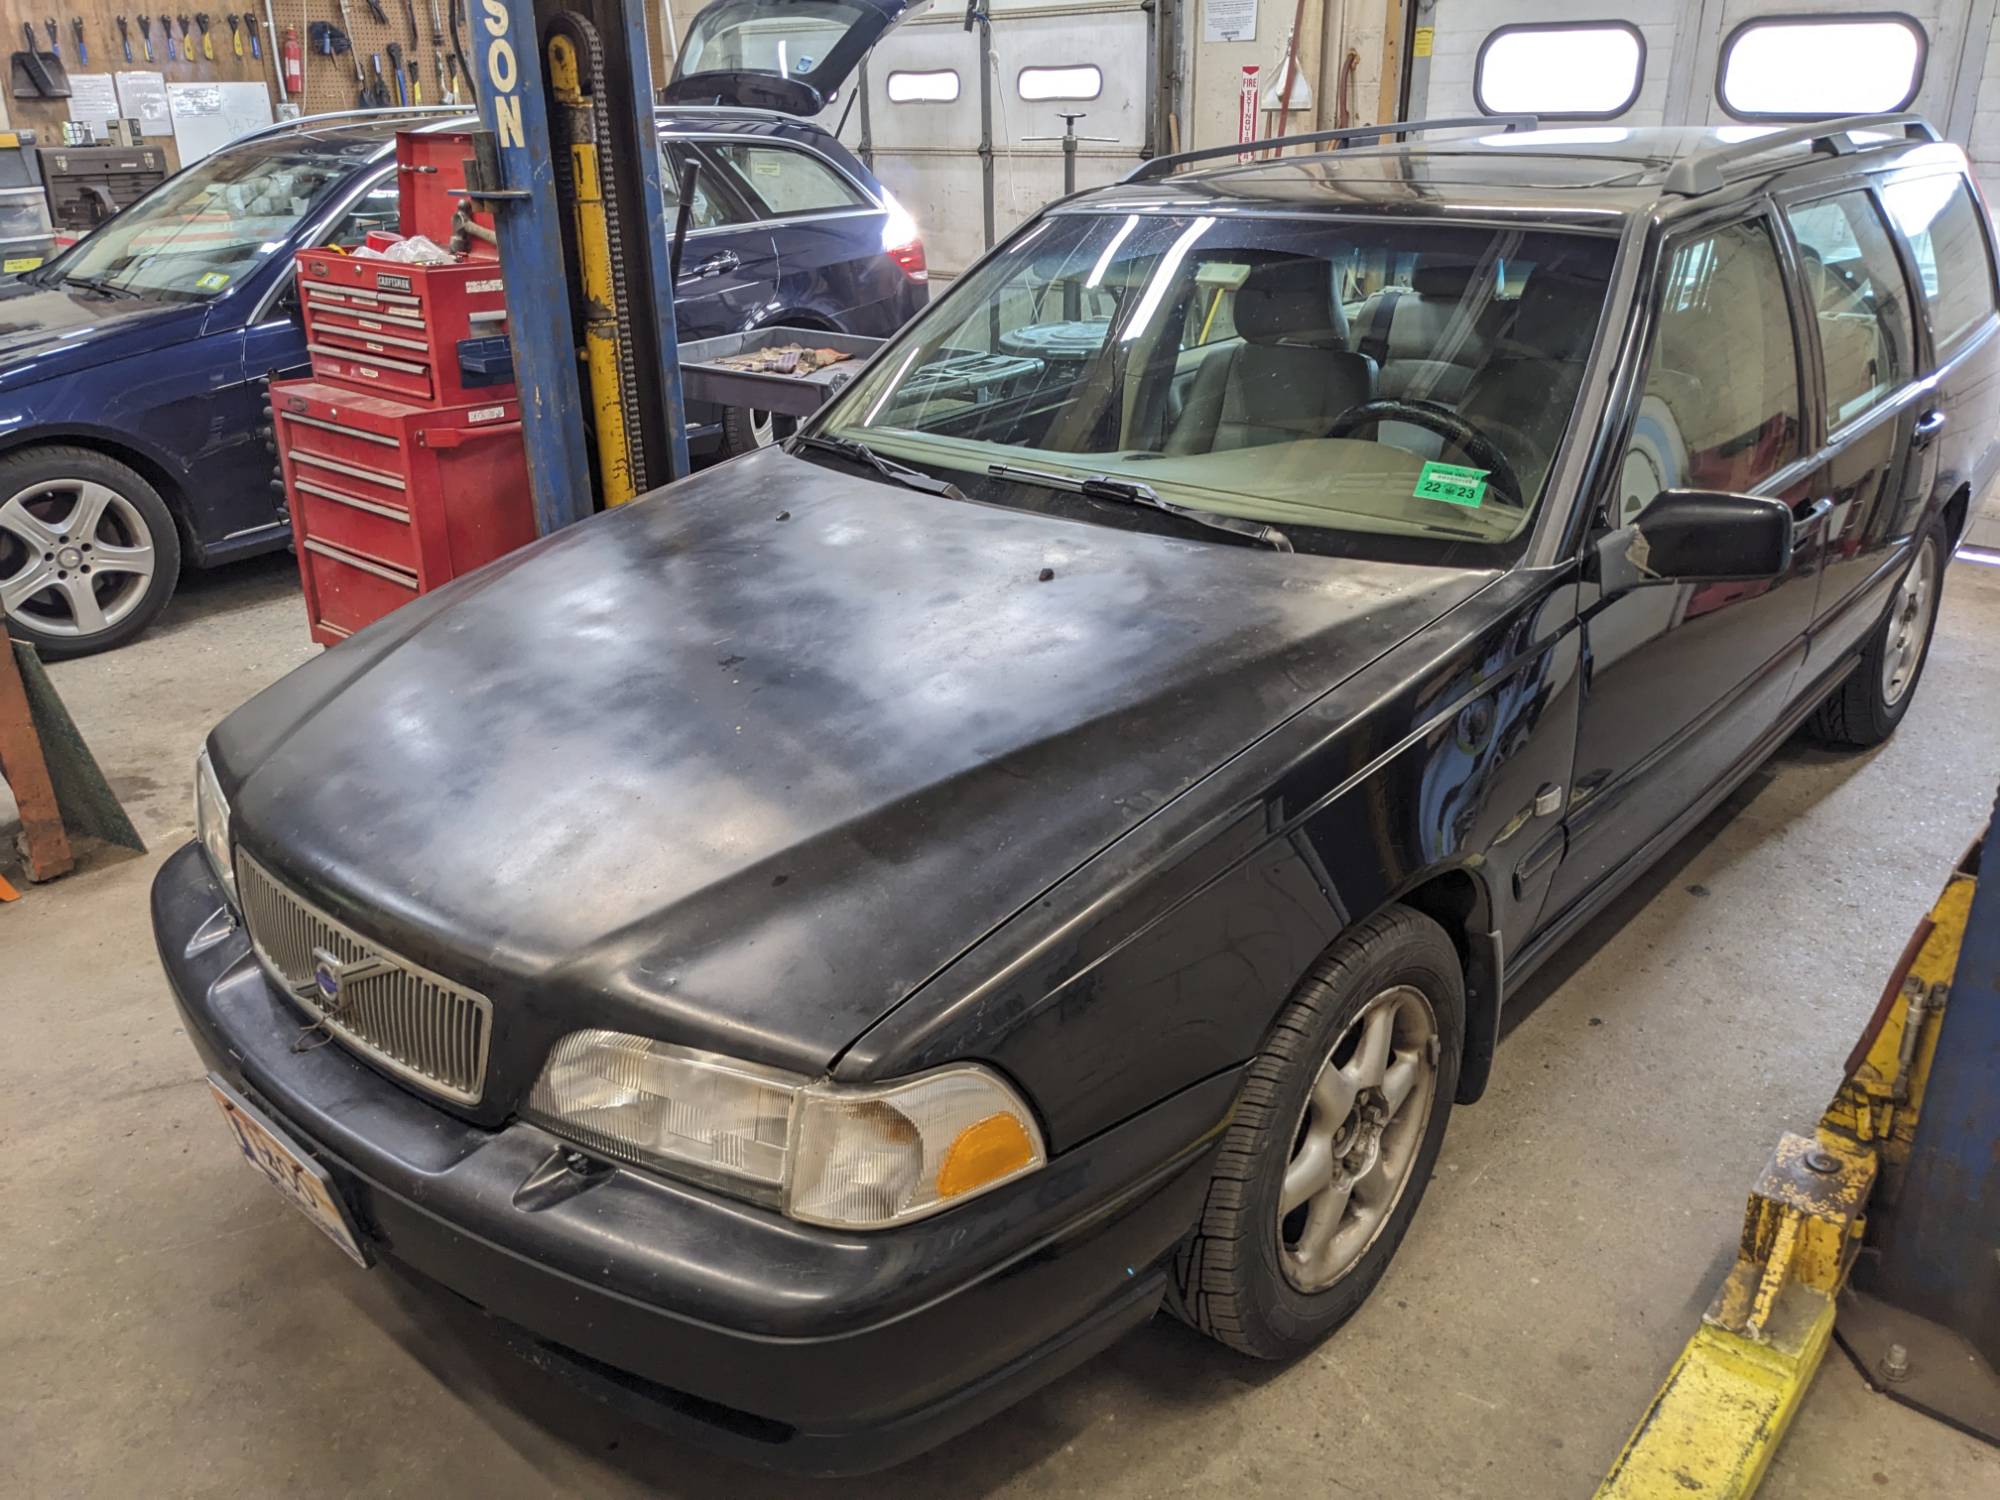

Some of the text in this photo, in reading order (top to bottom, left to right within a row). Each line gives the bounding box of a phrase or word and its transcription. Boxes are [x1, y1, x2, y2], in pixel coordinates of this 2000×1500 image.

[482, 0, 525, 147] SON
[1243, 78, 1257, 88] FIRE
[1424, 481, 1475, 499] 22 23
